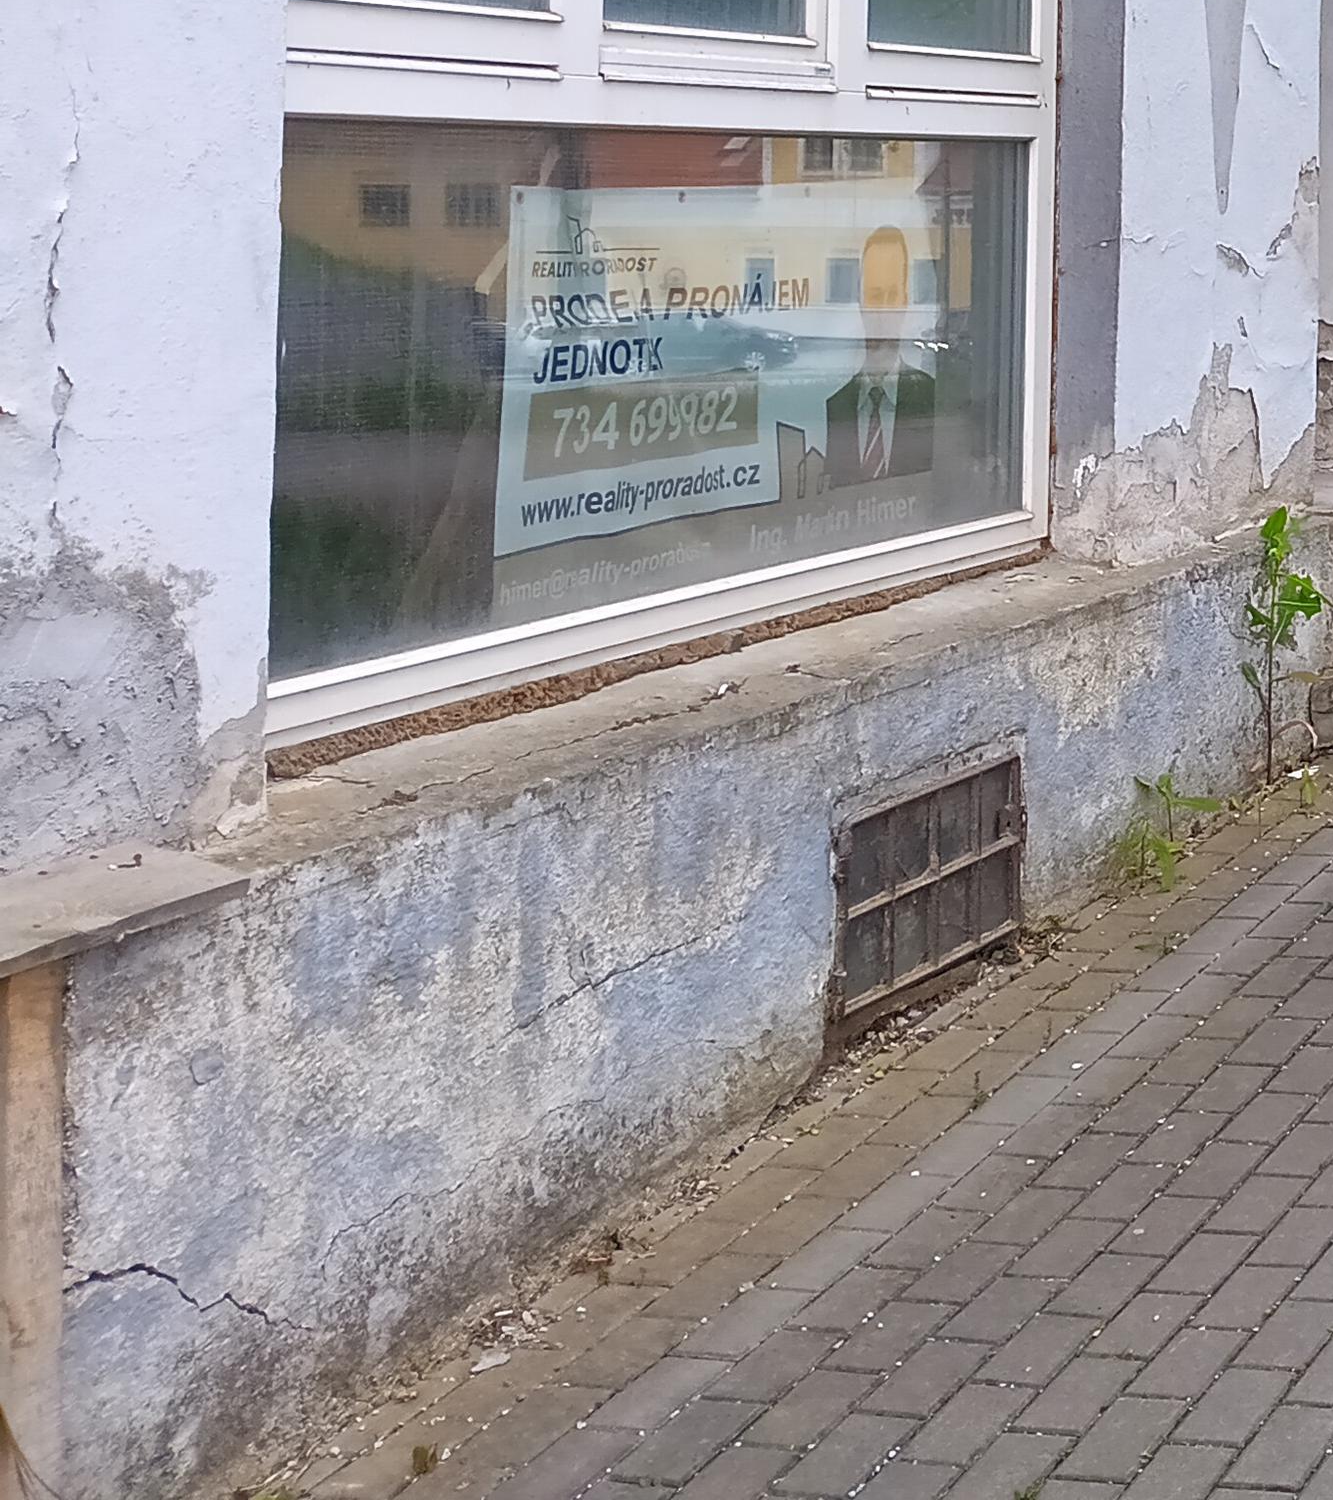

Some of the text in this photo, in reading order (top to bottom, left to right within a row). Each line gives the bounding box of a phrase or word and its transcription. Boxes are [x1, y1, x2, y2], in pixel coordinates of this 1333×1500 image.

[663, 273, 810, 321] PRONÁJEM
[552, 401, 620, 458] 734
[520, 464, 761, 528] www.reality-proradost.cz
[856, 496, 917, 526] Himer
